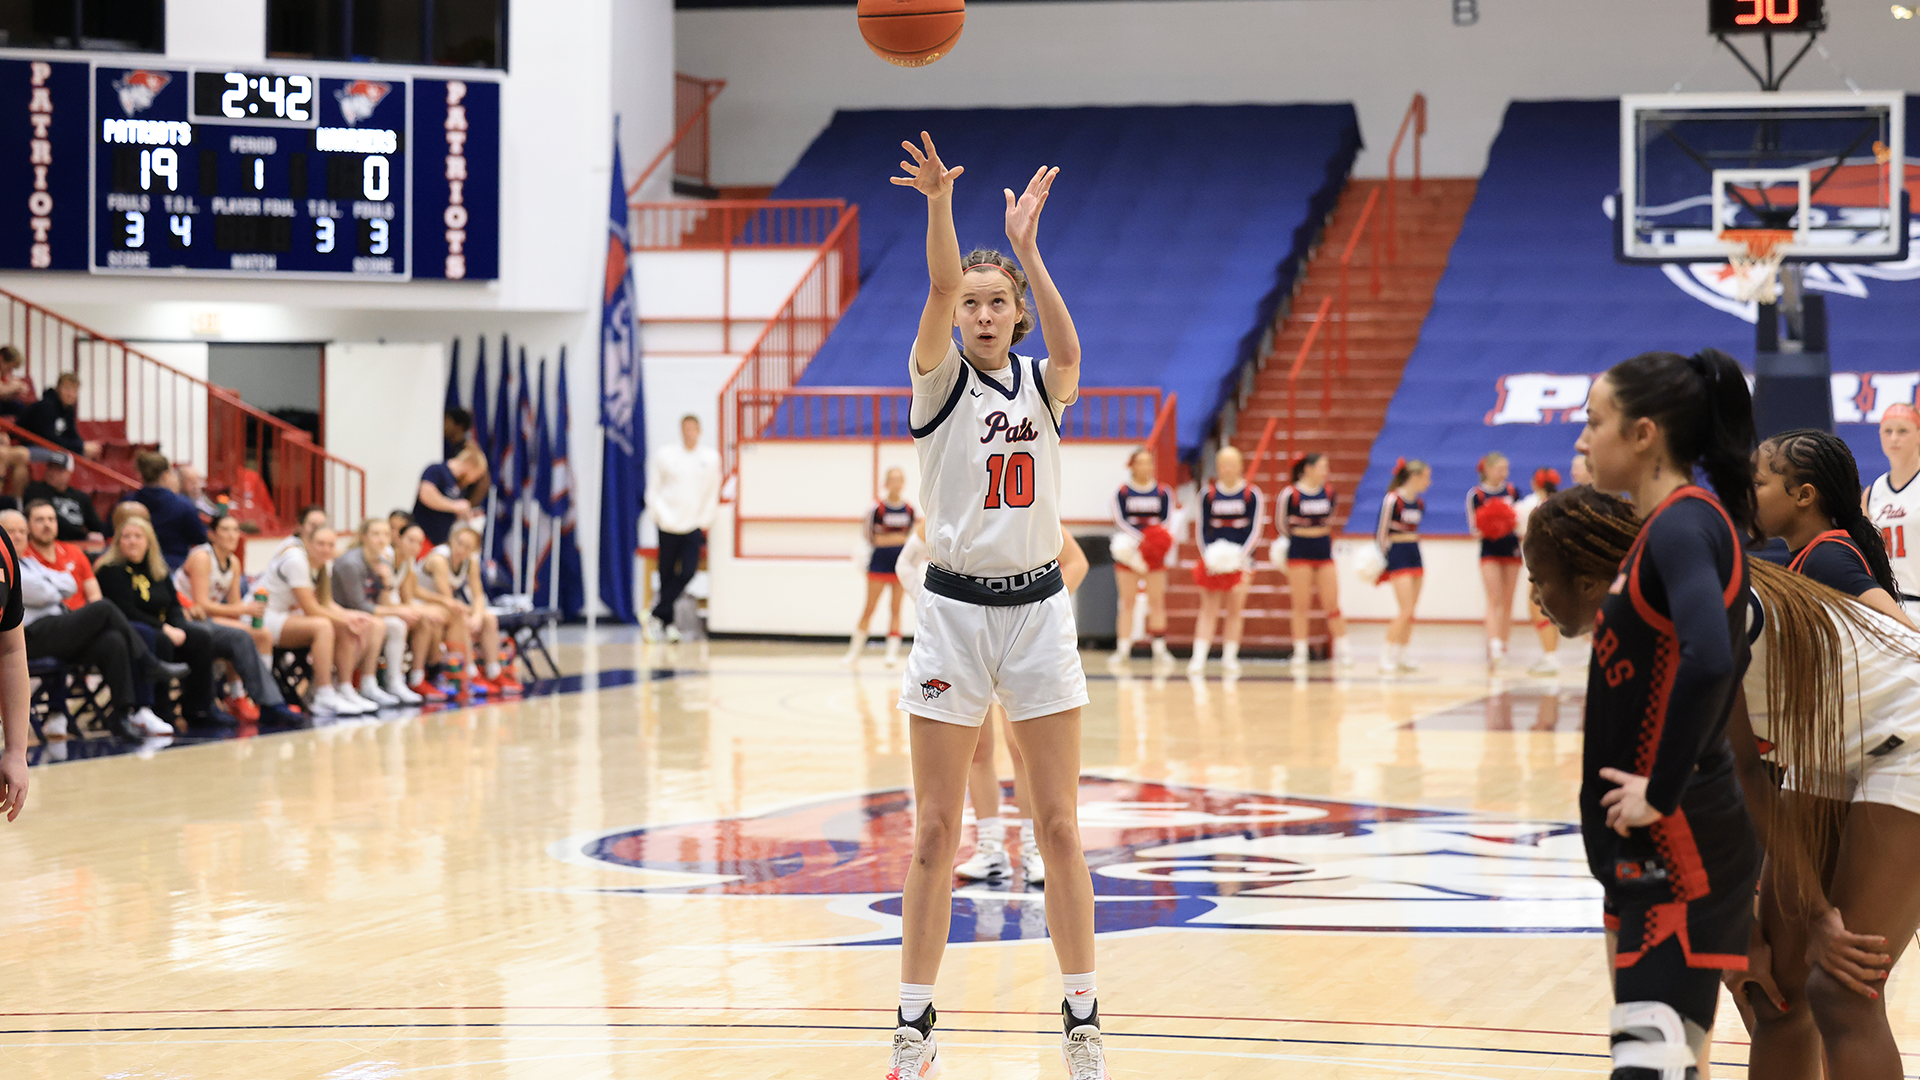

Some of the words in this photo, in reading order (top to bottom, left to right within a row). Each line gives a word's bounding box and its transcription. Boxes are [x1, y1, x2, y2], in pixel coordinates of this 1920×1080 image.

[222, 72, 312, 121] 2:42
[103, 118, 192, 146] PATRIOTS
[29, 61, 53, 269] PATRIOTS
[140, 147, 178, 191] 19
[254, 157, 264, 190] 1
[363, 155, 390, 201] 0
[444, 79, 469, 279] PATRIOTS
[125, 211, 145, 248] 3
[170, 214, 192, 247] 4
[315, 216, 335, 253] 3
[369, 218, 389, 254] 3
[979, 410, 1039, 444] Pats
[983, 452, 1035, 510] 10
[1875, 503, 1907, 522] Pats
